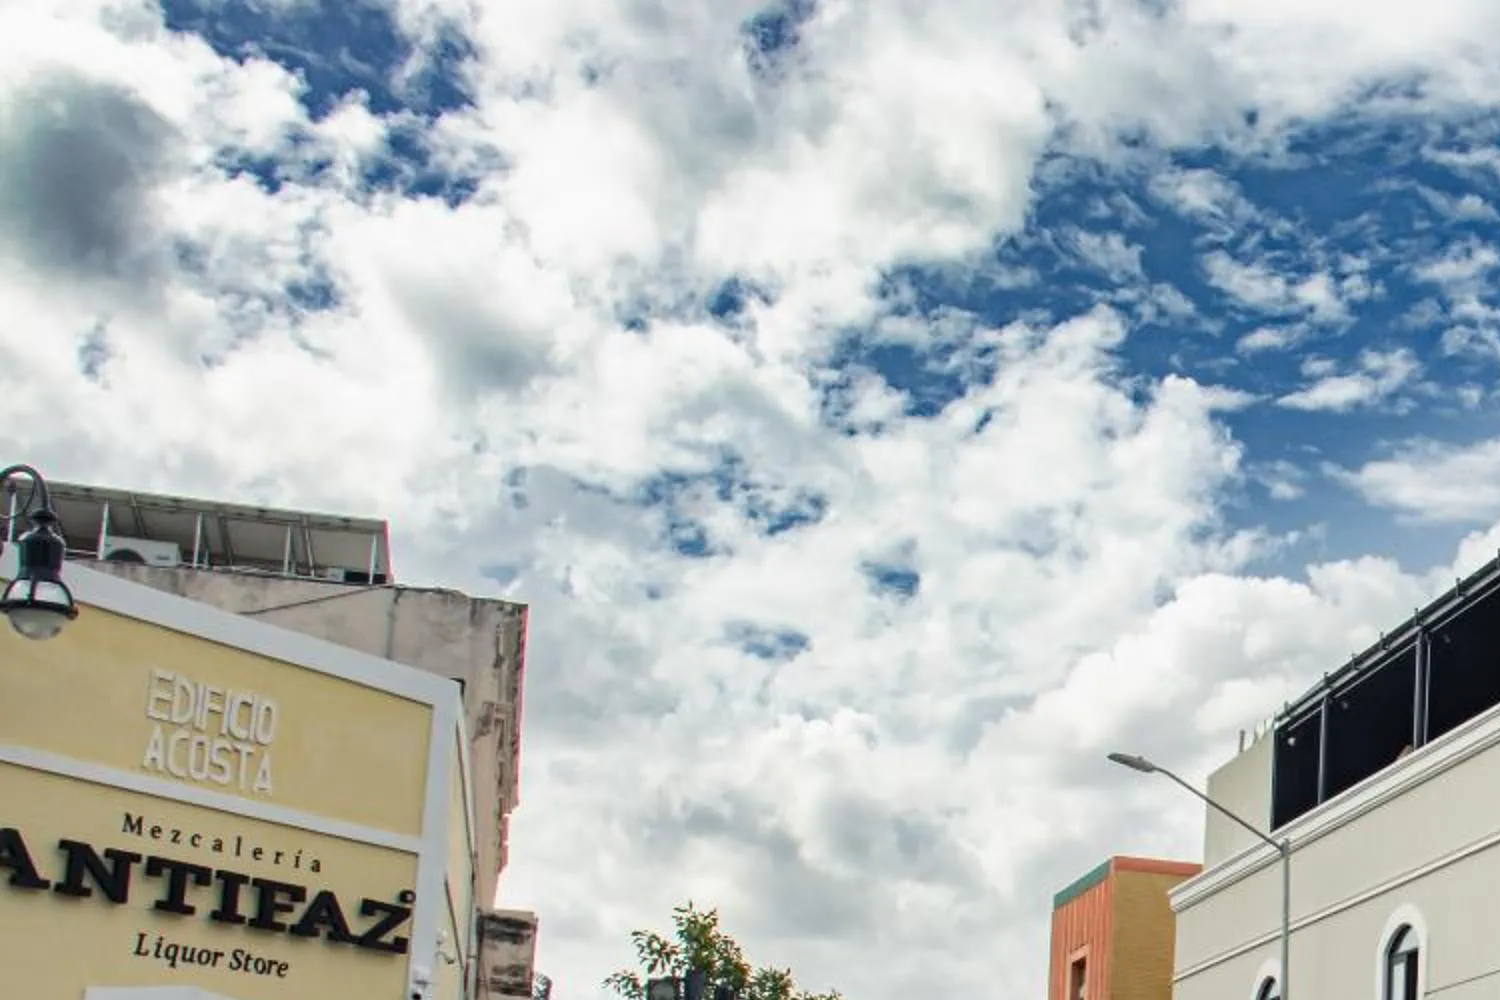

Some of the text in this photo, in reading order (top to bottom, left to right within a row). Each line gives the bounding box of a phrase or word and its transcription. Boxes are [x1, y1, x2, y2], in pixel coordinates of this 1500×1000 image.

[146, 668, 278, 745] EDIFICIO
[143, 726, 273, 796] ACOSTA
[122, 812, 322, 874] Mezcalería
[134, 932, 290, 979] Liquor Store
